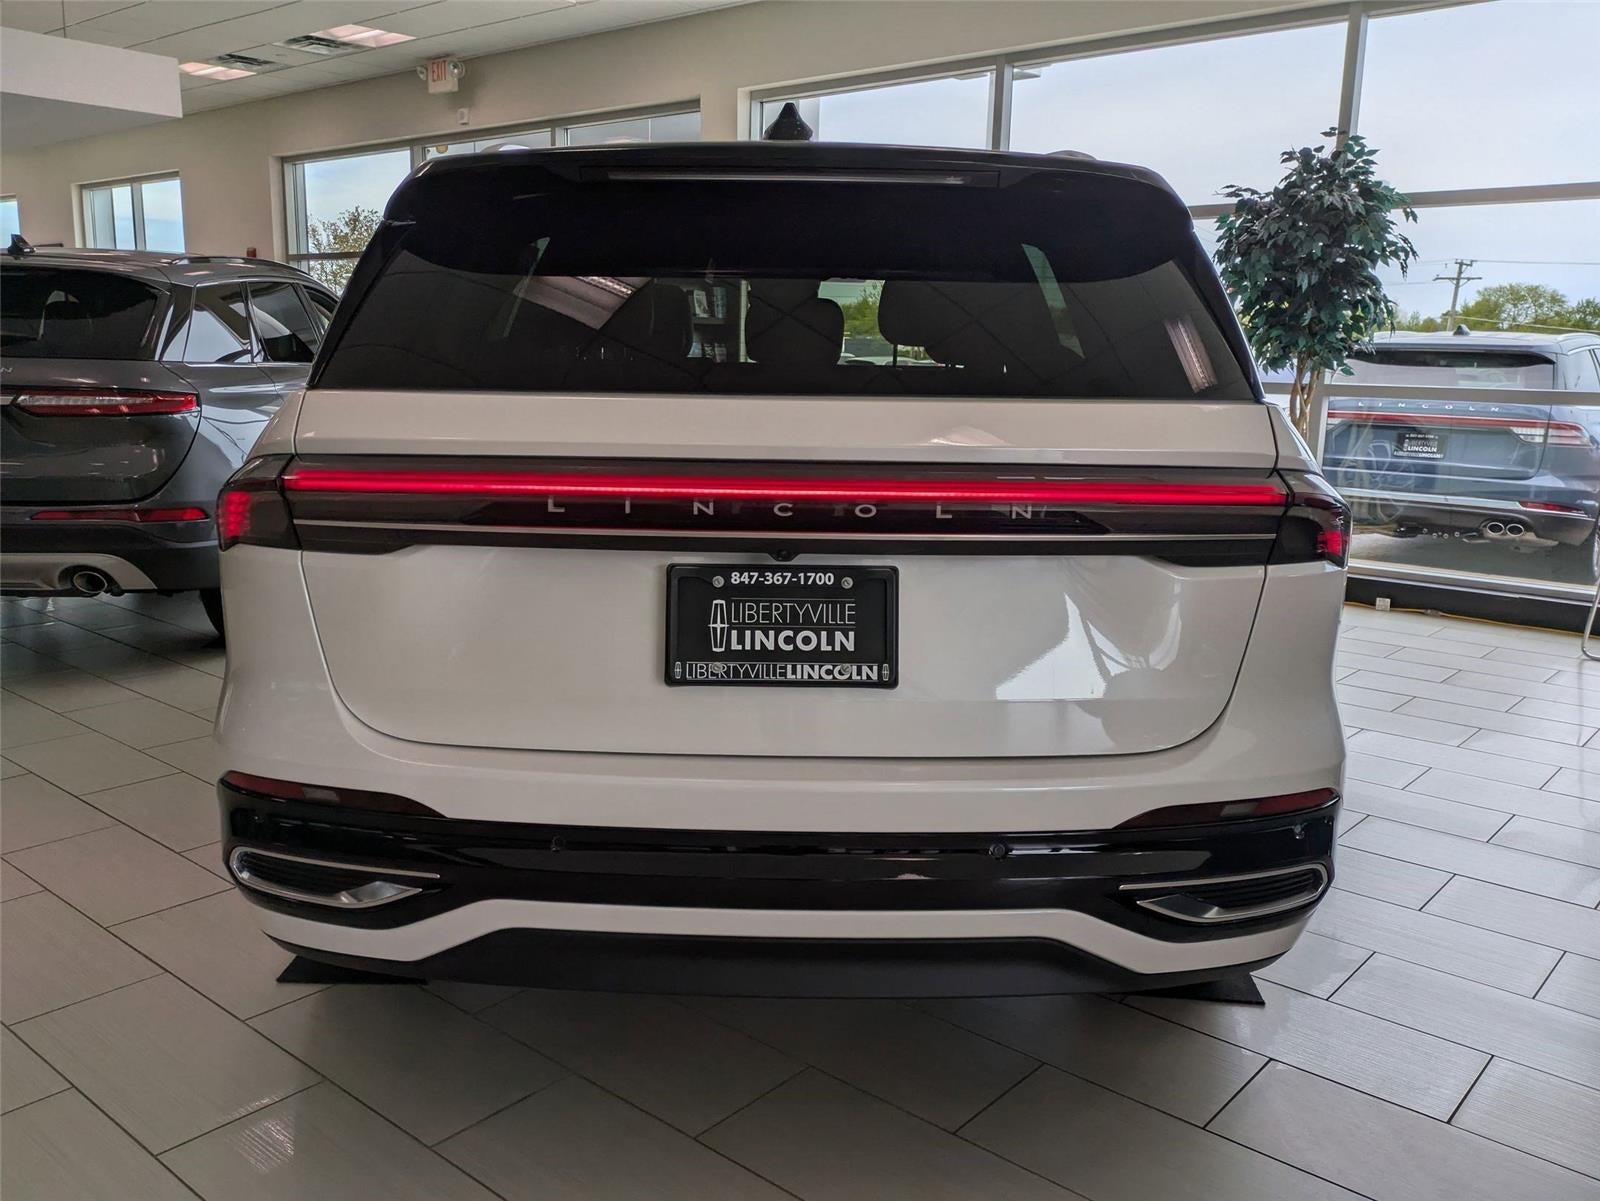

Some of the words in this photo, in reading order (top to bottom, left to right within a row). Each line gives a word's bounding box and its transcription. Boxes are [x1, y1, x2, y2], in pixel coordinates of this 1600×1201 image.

[432, 60, 448, 82] EXIT
[1358, 401, 1500, 412] LINCOLN
[547, 497, 1032, 519] LINCOLN
[730, 572, 835, 586] 847-367-1700
[730, 602, 856, 625] LIBERTYVILLE
[730, 629, 855, 652] LINCOLN
